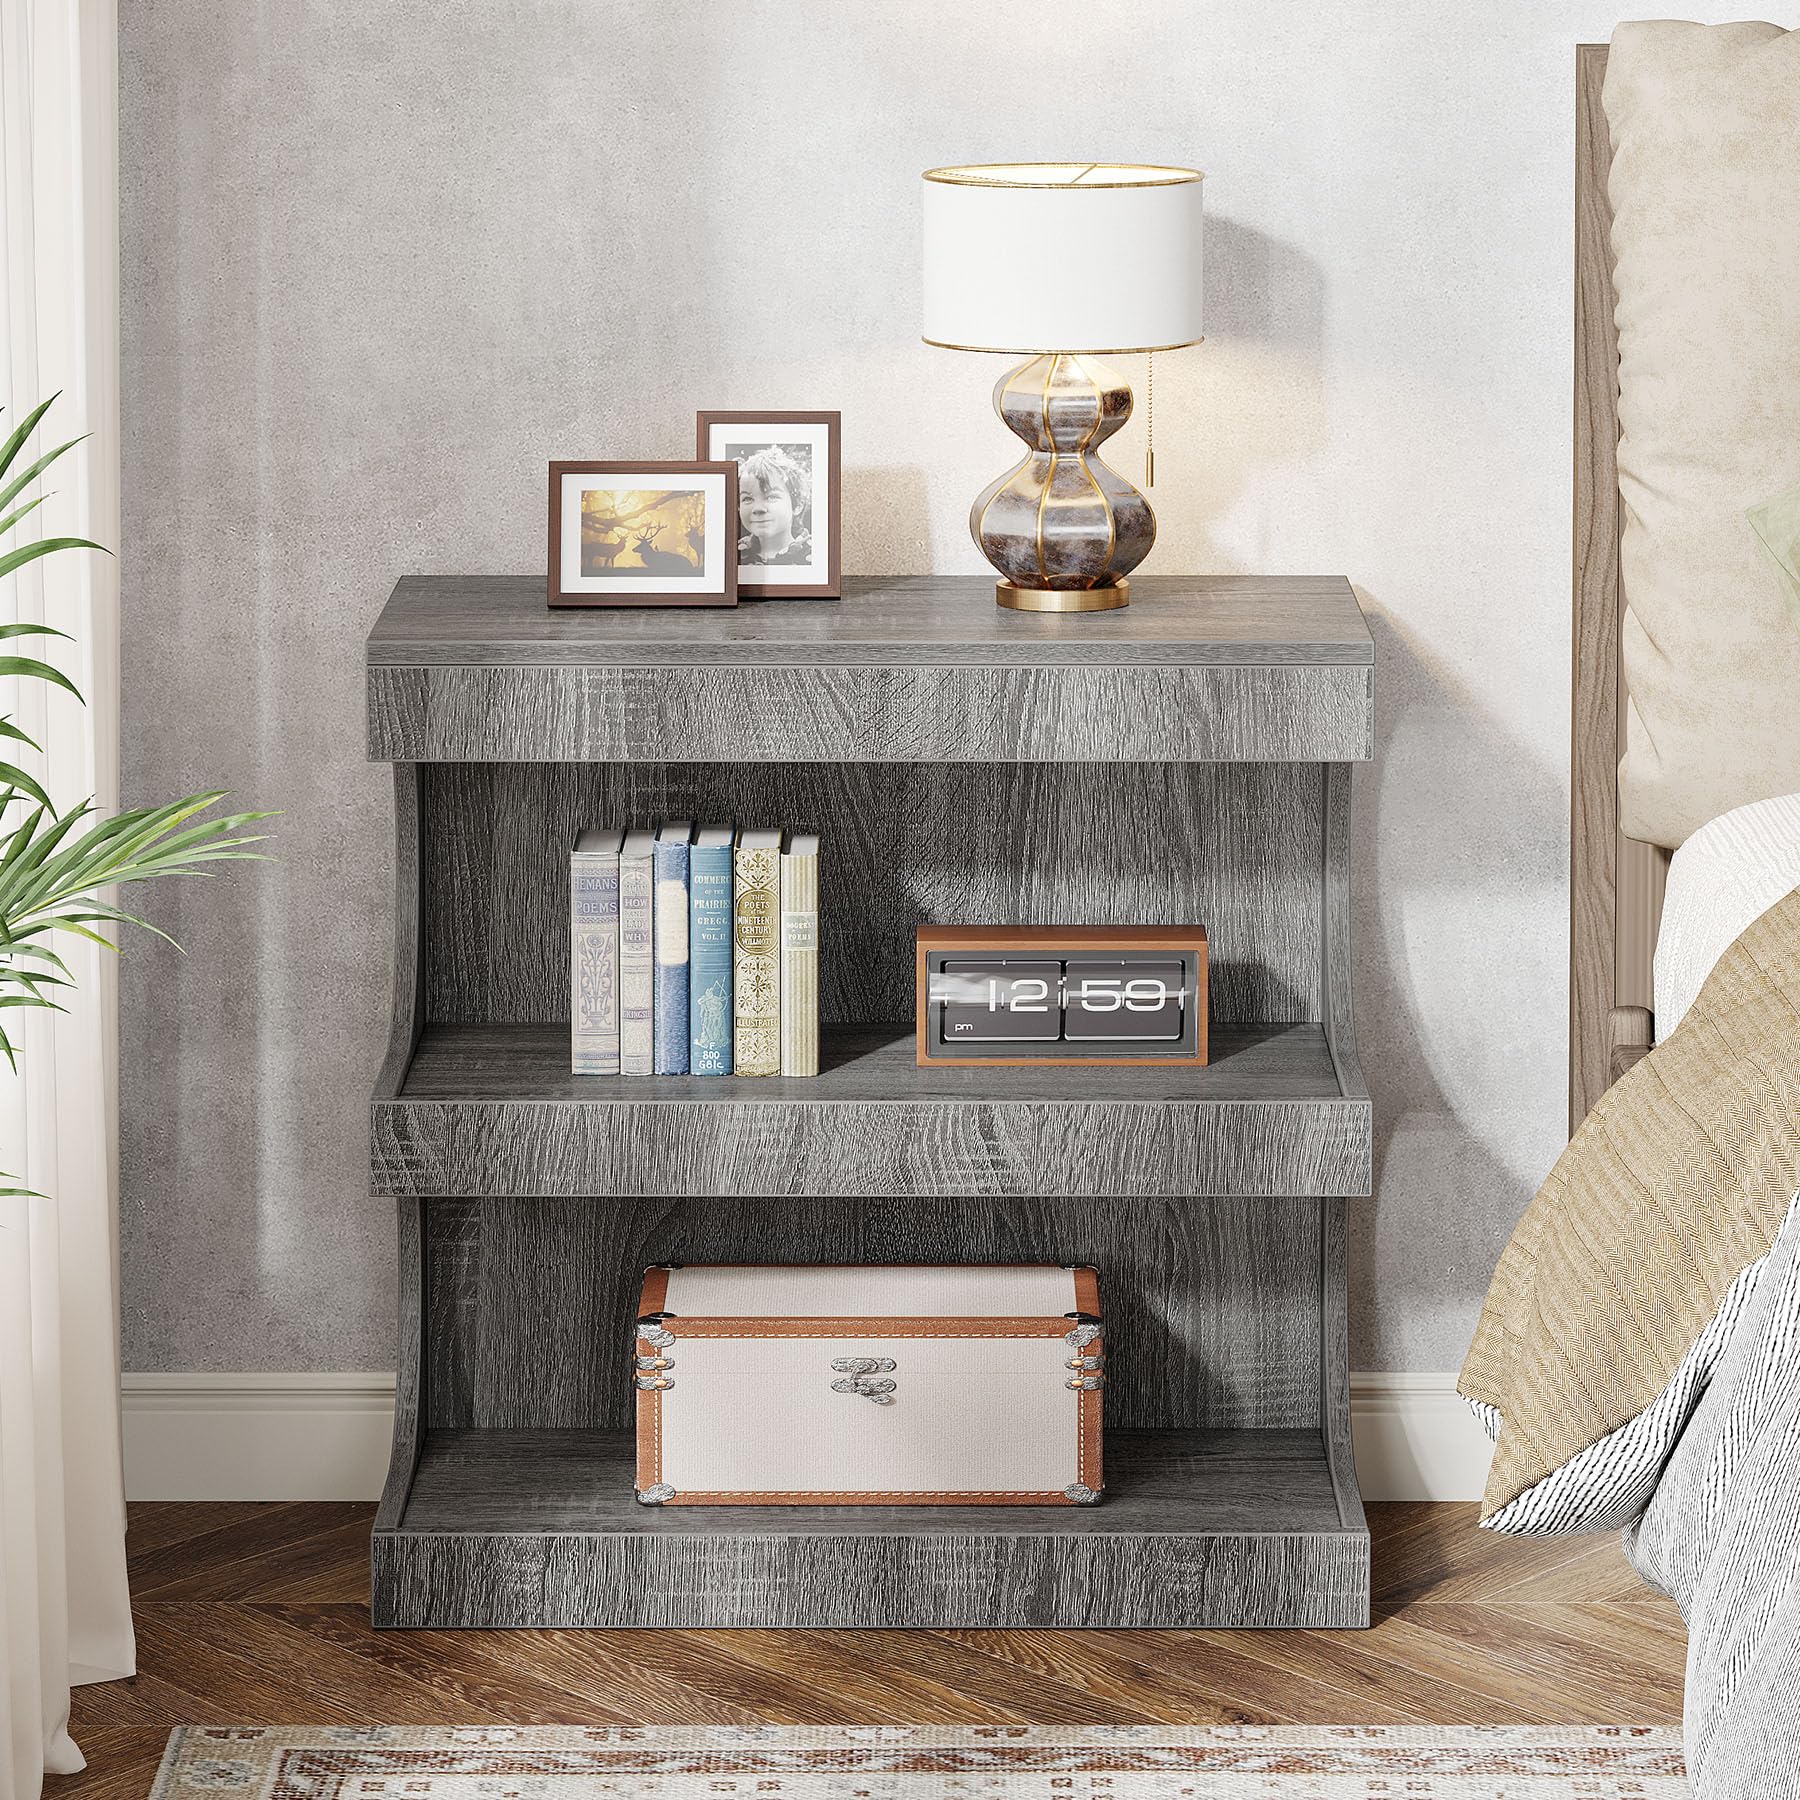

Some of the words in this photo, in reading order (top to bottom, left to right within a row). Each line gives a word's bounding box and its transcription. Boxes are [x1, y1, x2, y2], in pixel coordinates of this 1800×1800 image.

[575, 878, 618, 890] HEMANS
[575, 901, 618, 913] POEMS
[624, 898, 648, 907] HOW
[744, 901, 770, 909] POETS
[741, 926, 772, 934] CENTURY
[624, 933, 648, 941] WHY
[954, 1022, 974, 1032] pm
[709, 1042, 715, 1050] F
[702, 1050, 720, 1060] 800
